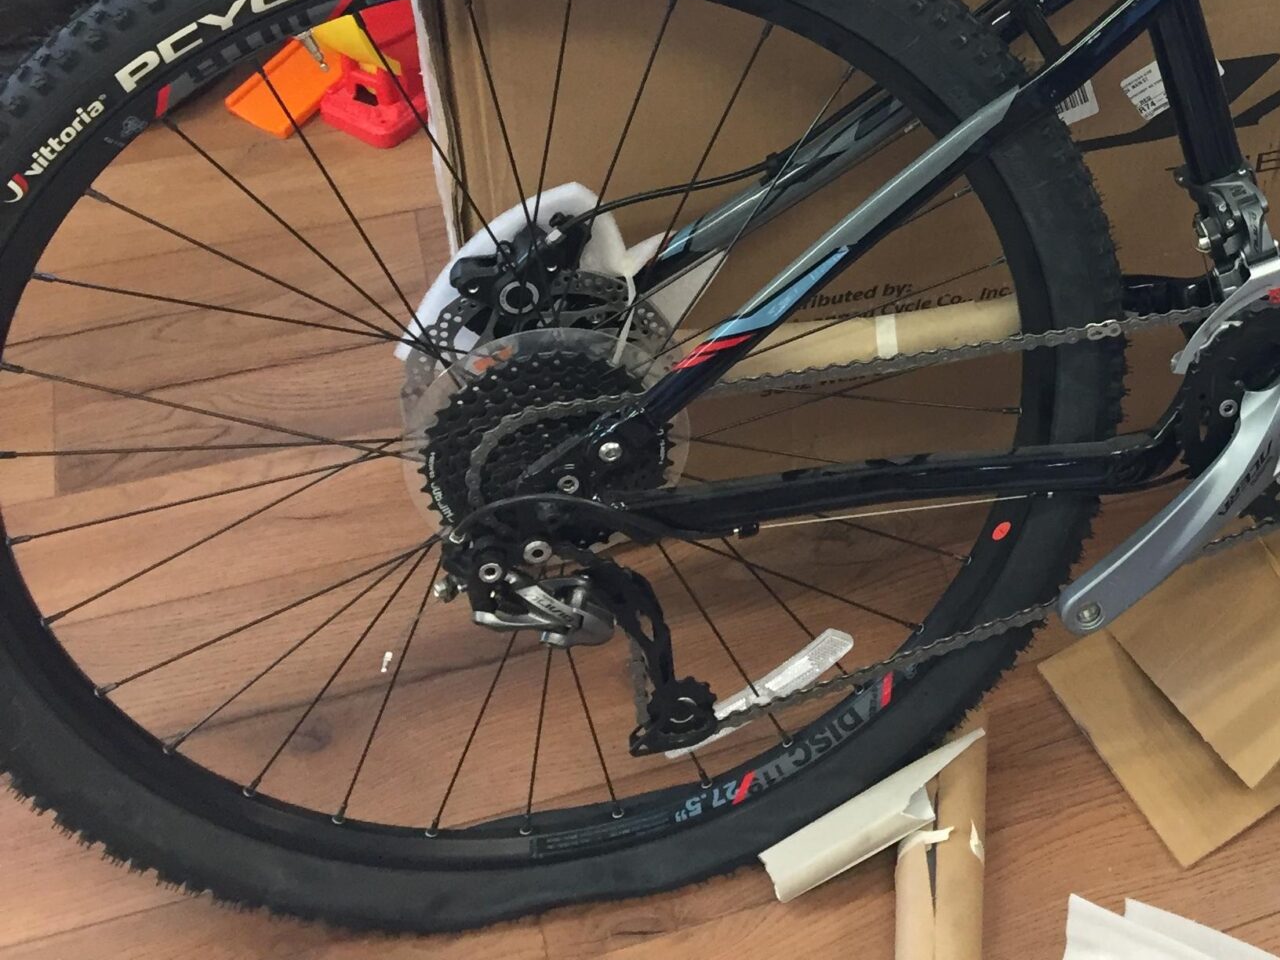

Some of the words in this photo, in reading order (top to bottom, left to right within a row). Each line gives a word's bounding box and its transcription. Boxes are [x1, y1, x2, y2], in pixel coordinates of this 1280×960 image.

[880, 298, 932, 315] Cycle
[980, 285, 1013, 300] Inc.
[882, 283, 913, 297] by:
[791, 707, 865, 767] DISC
[675, 778, 741, 824] 27.5"
